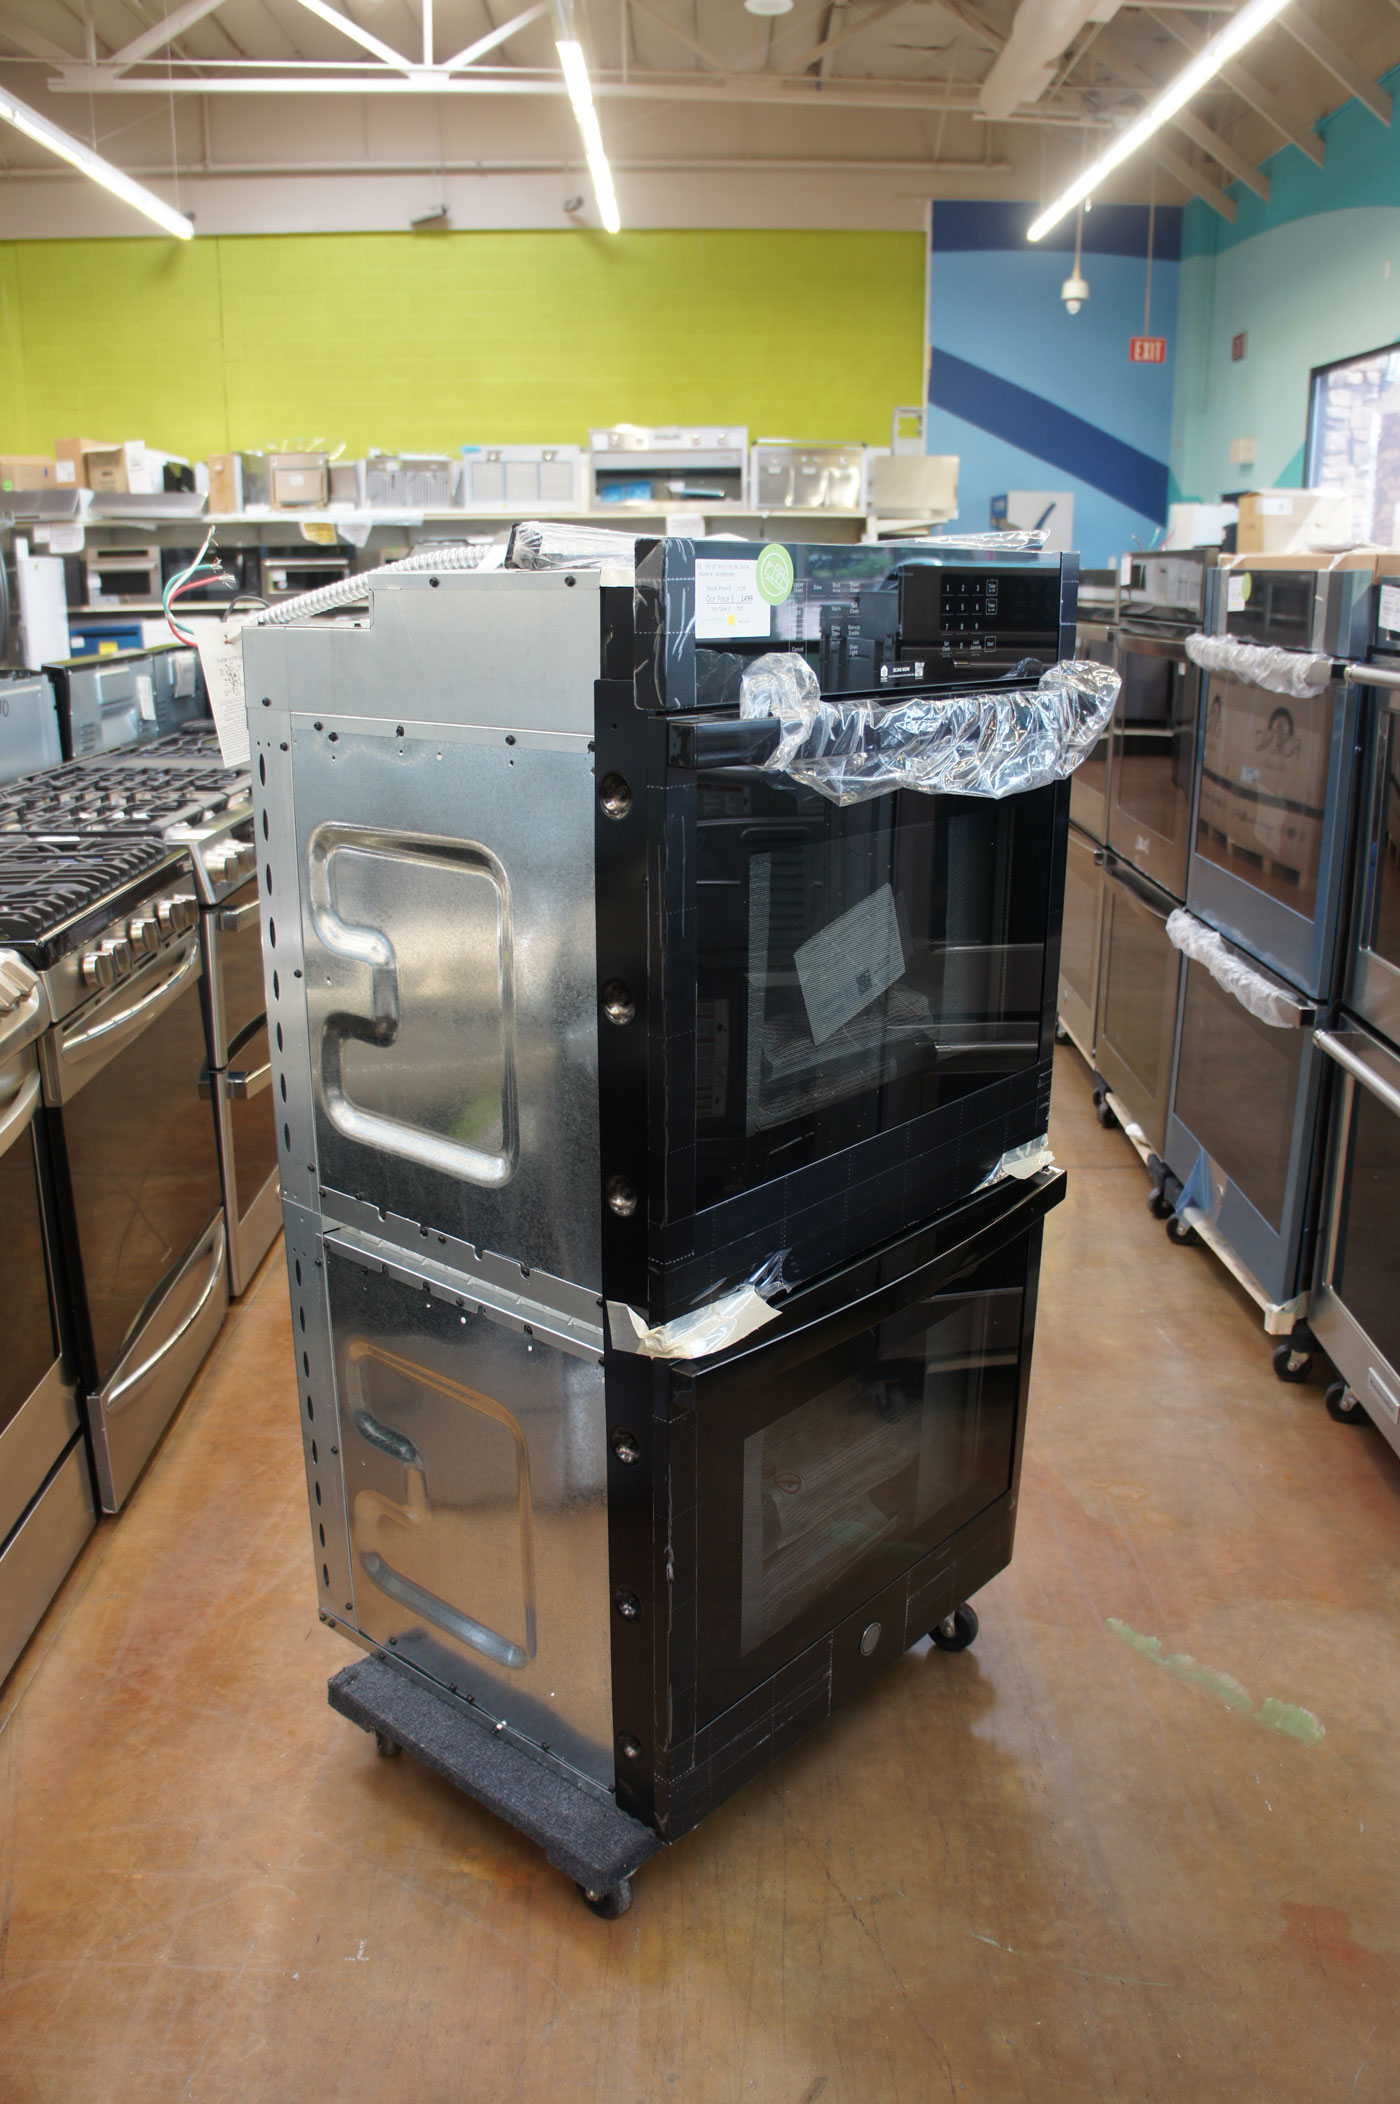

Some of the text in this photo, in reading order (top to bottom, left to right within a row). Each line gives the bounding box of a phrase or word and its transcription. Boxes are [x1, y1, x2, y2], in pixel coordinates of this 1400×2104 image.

[1135, 341, 1162, 360] EXIT
[706, 594, 716, 603] Our
[717, 594, 730, 603] Price
[740, 594, 753, 603] 1499
